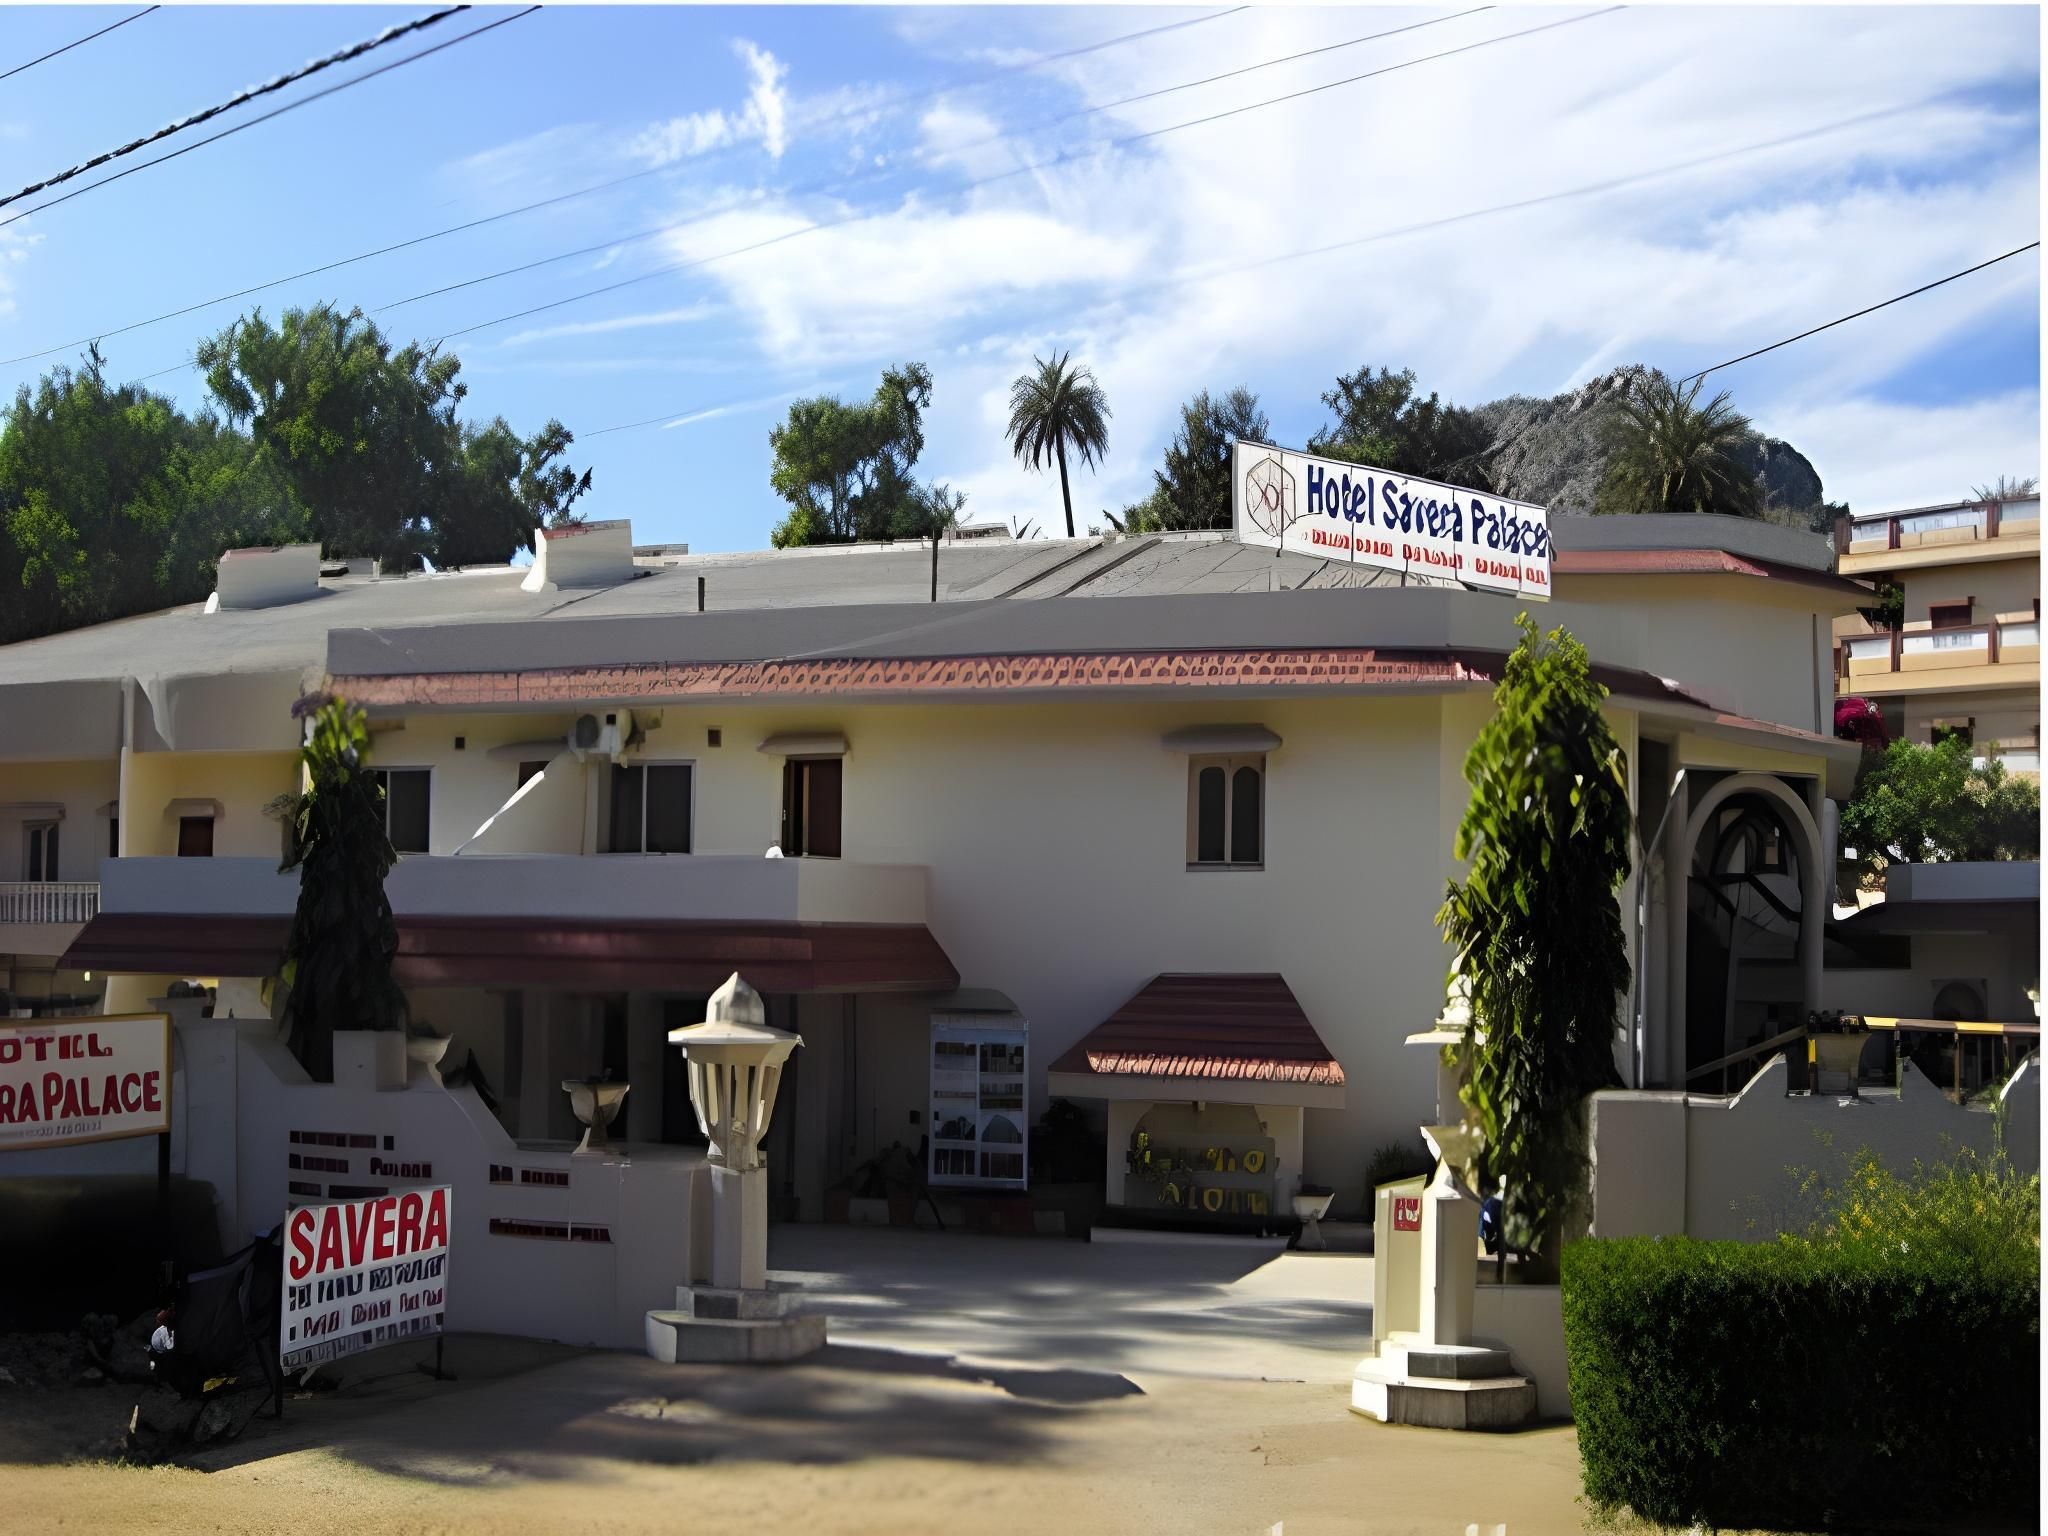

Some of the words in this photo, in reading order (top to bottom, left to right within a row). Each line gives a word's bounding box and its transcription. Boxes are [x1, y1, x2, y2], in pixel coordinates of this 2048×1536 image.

[1307, 464, 1375, 526] Hotel
[43, 1071, 162, 1121] PALACE
[289, 1189, 448, 1281] SAVERA
